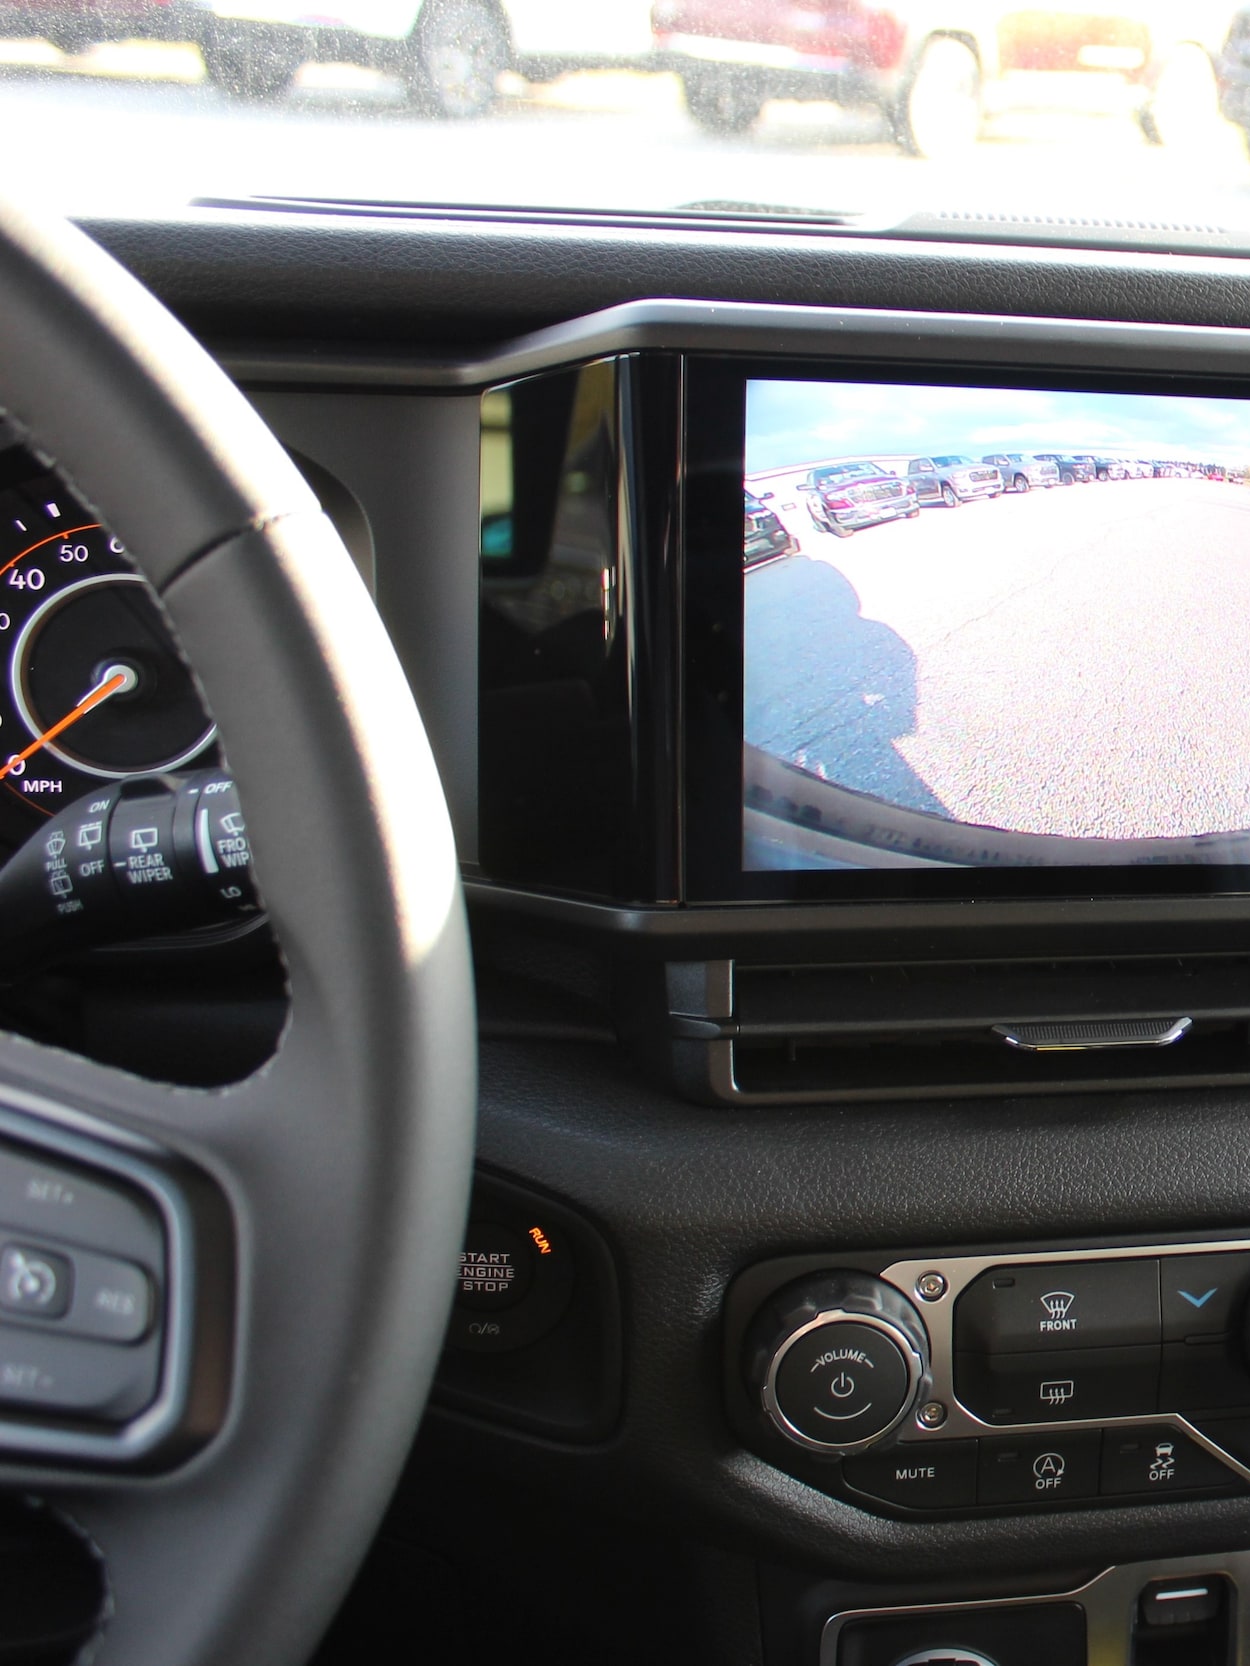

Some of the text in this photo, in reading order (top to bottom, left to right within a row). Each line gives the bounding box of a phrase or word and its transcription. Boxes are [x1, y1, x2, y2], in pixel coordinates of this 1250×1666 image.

[60, 544, 89, 563] 50
[8, 568, 45, 591] 40
[23, 779, 63, 795] MPH
[204, 781, 233, 794] OFF
[88, 798, 111, 814] ON
[217, 837, 248, 855] FRO
[46, 859, 67, 872] PULL
[128, 853, 164, 870] REAR
[219, 851, 250, 868] WIP
[79, 860, 106, 877] OFF
[128, 868, 173, 883] WIPER
[220, 886, 242, 900] LO
[528, 1226, 552, 1257] RUN
[458, 1252, 511, 1264] START
[456, 1266, 515, 1278] ENGINE
[463, 1281, 509, 1292] STOP
[1040, 1318, 1078, 1332] FRONT
[815, 1349, 866, 1367] VOLUME
[895, 1466, 935, 1480] MUTE
[1148, 1468, 1176, 1482] OFF
[1034, 1477, 1062, 1490] OFF
